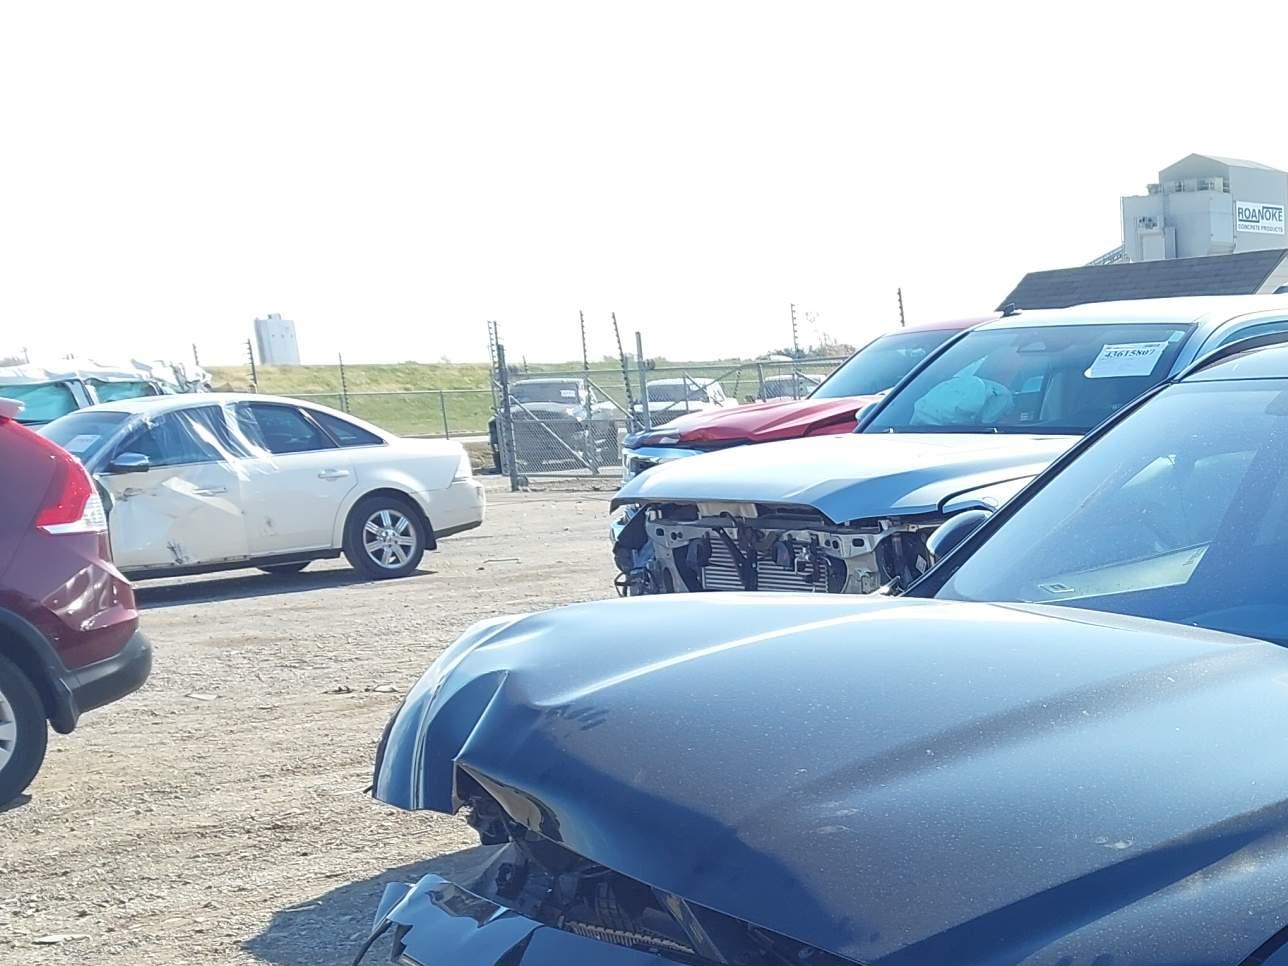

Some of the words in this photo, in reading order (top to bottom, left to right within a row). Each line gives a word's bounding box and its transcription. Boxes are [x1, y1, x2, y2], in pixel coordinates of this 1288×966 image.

[1238, 206, 1283, 223] ROANOKE
[1238, 223, 1260, 231] CONCRETE
[1260, 225, 1283, 233] PRODUCTS
[1104, 348, 1155, 358] 43615807
